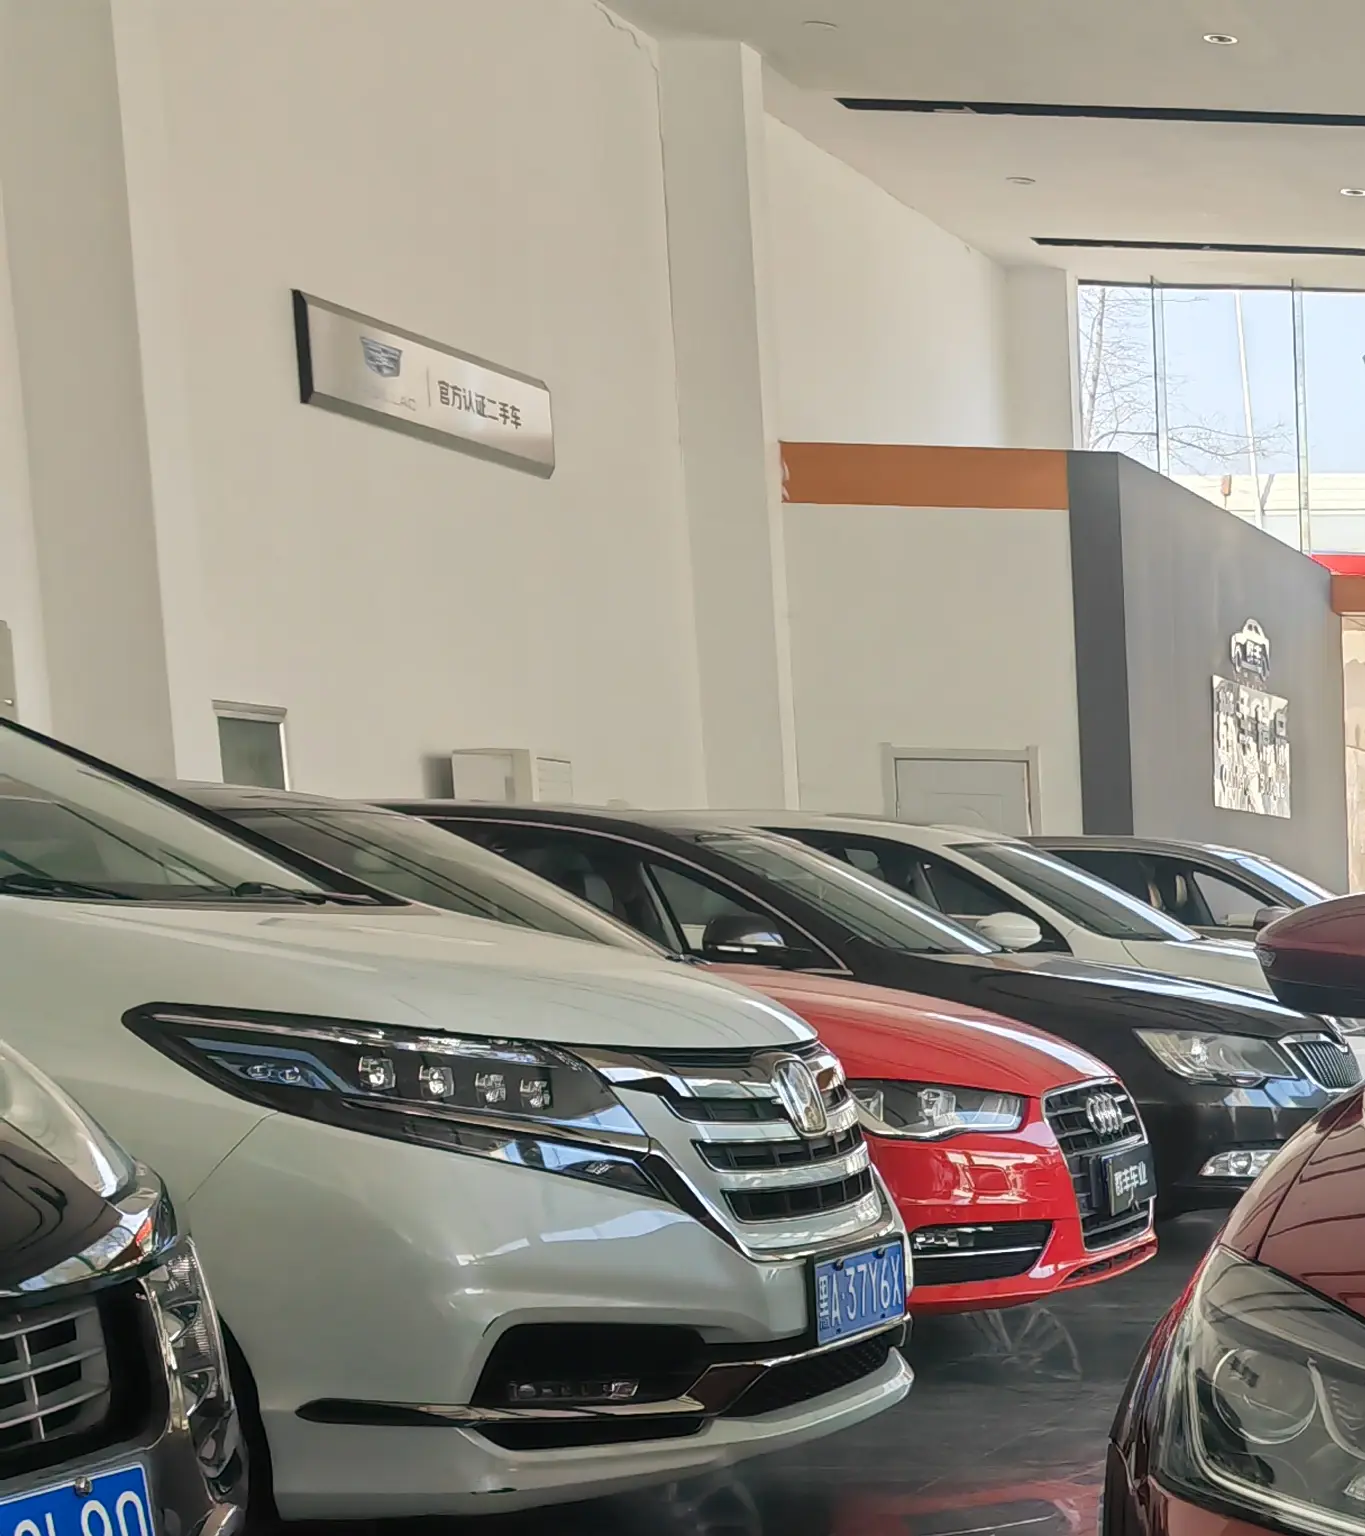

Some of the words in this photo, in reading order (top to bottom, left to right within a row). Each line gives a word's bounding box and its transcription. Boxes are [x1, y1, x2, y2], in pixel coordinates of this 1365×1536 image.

[437, 380, 522, 430] 官方认证二手车
[1113, 1161, 1149, 1197] 群丰车业
